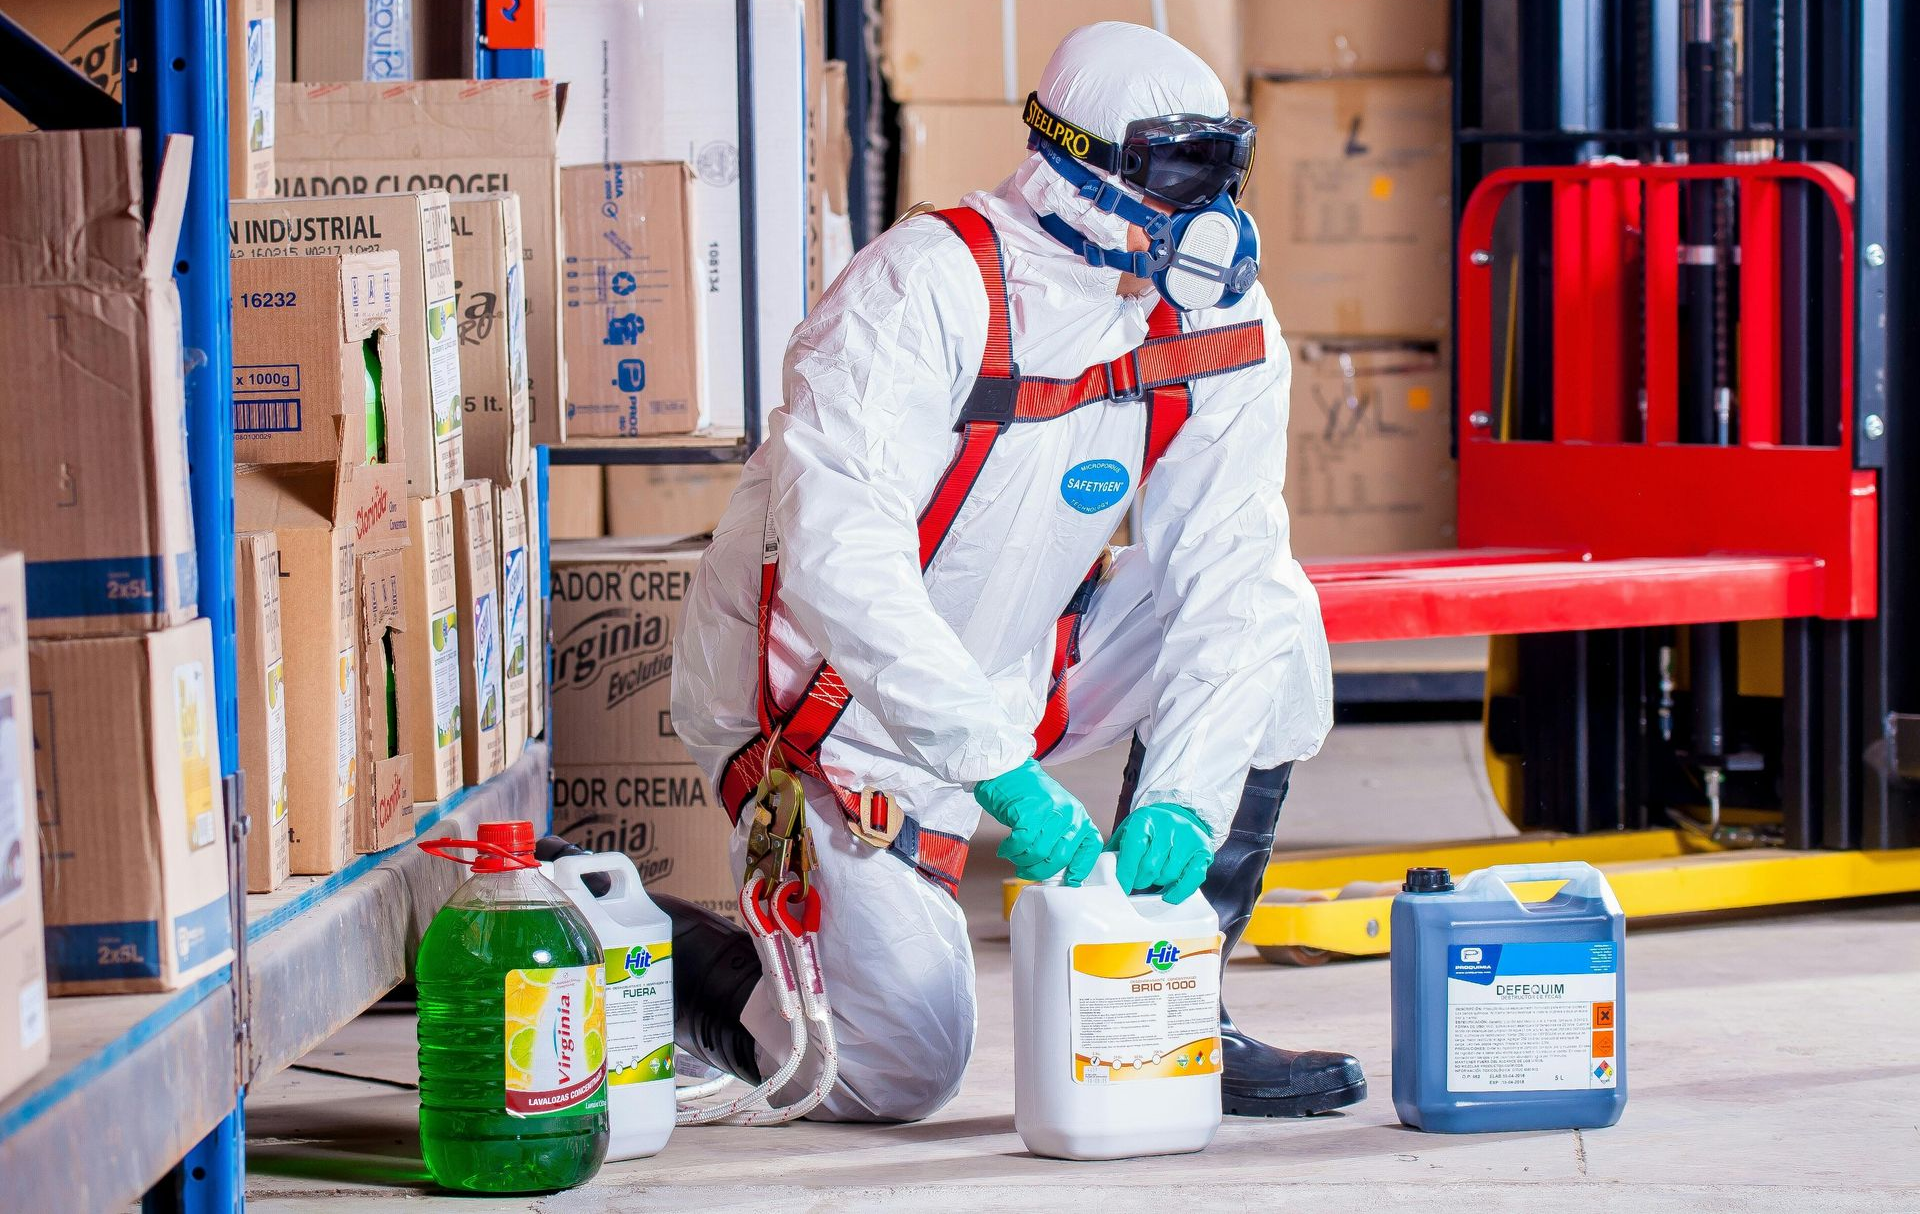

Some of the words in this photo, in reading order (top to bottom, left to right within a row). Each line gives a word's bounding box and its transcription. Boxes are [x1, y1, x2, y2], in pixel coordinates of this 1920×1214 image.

[70, 26, 121, 90] gi
[1027, 100, 1089, 158] STEELPRO
[245, 215, 382, 244] INDUSTRIAL
[241, 292, 297, 308] 16232
[236, 376, 244, 385] x
[249, 373, 290, 387] 1000g
[464, 396, 476, 412] 5
[484, 396, 503, 412] lt.
[106, 581, 153, 599] 2x5L
[553, 778, 607, 808] DOR
[615, 778, 706, 808] CREMA
[573, 819, 647, 852] inia
[98, 944, 144, 964] 2x5L
[624, 949, 652, 969] Hit
[1146, 944, 1180, 964] Hit
[623, 986, 656, 998] FUERA
[1131, 982, 1163, 993] BRIO
[1166, 980, 1196, 990] 1000
[1496, 983, 1564, 995] DEFEQUIM
[558, 993, 575, 1085] Virginia
[528, 1092, 569, 1106] LAVALOZAS
